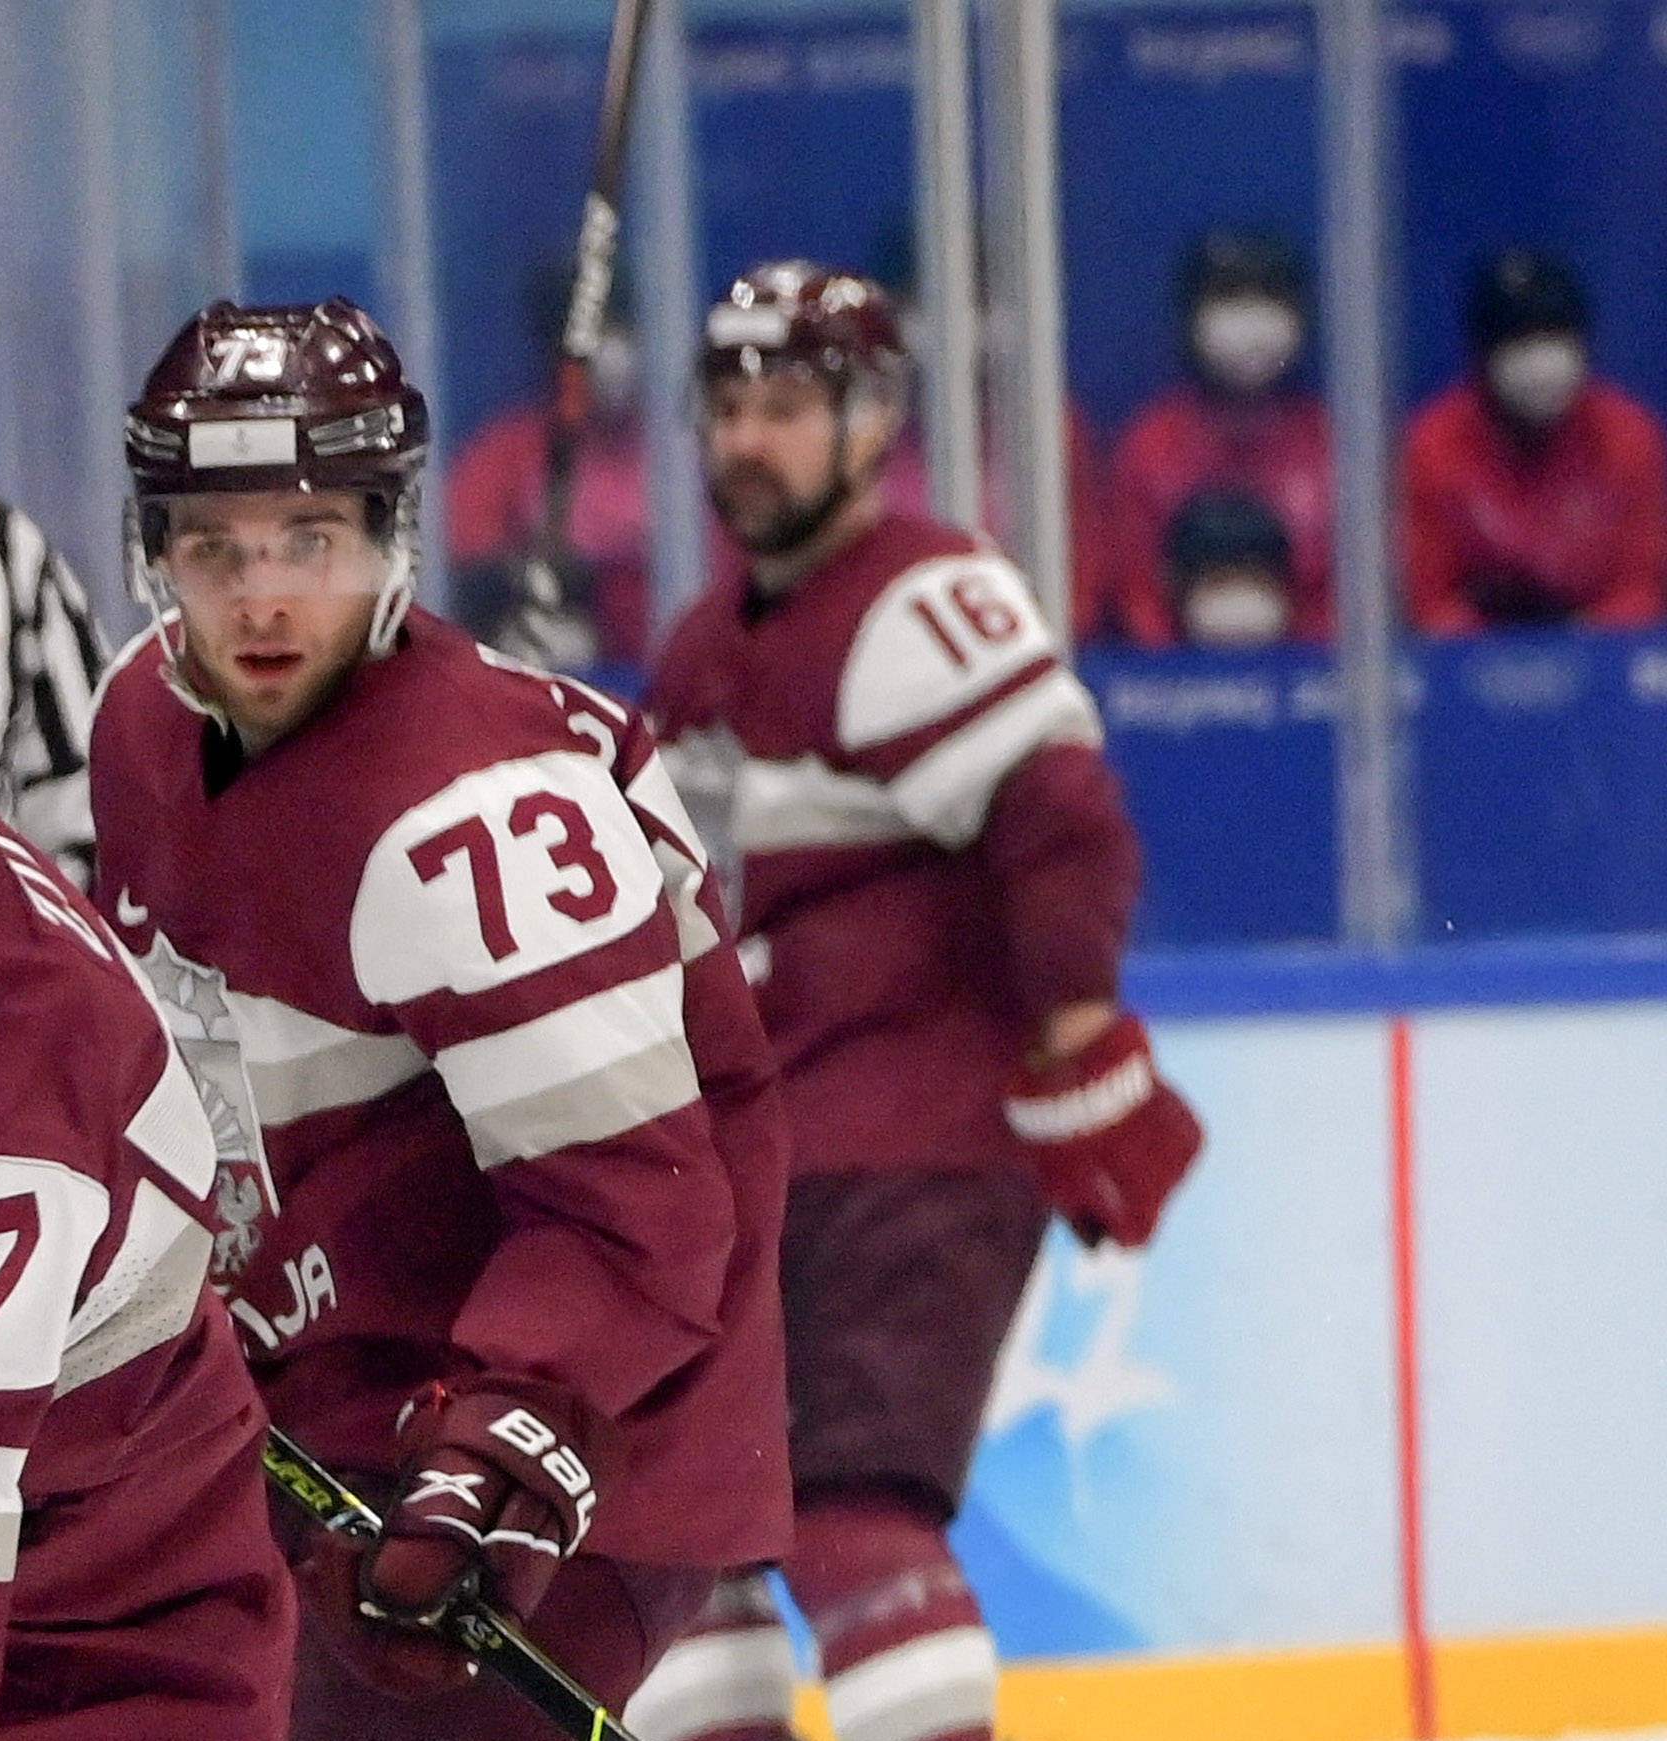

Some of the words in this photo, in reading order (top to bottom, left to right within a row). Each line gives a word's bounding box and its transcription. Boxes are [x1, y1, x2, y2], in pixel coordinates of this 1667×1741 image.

[913, 573, 1022, 669] 16
[405, 788, 620, 964] 73
[487, 1407, 598, 1558] Bau
